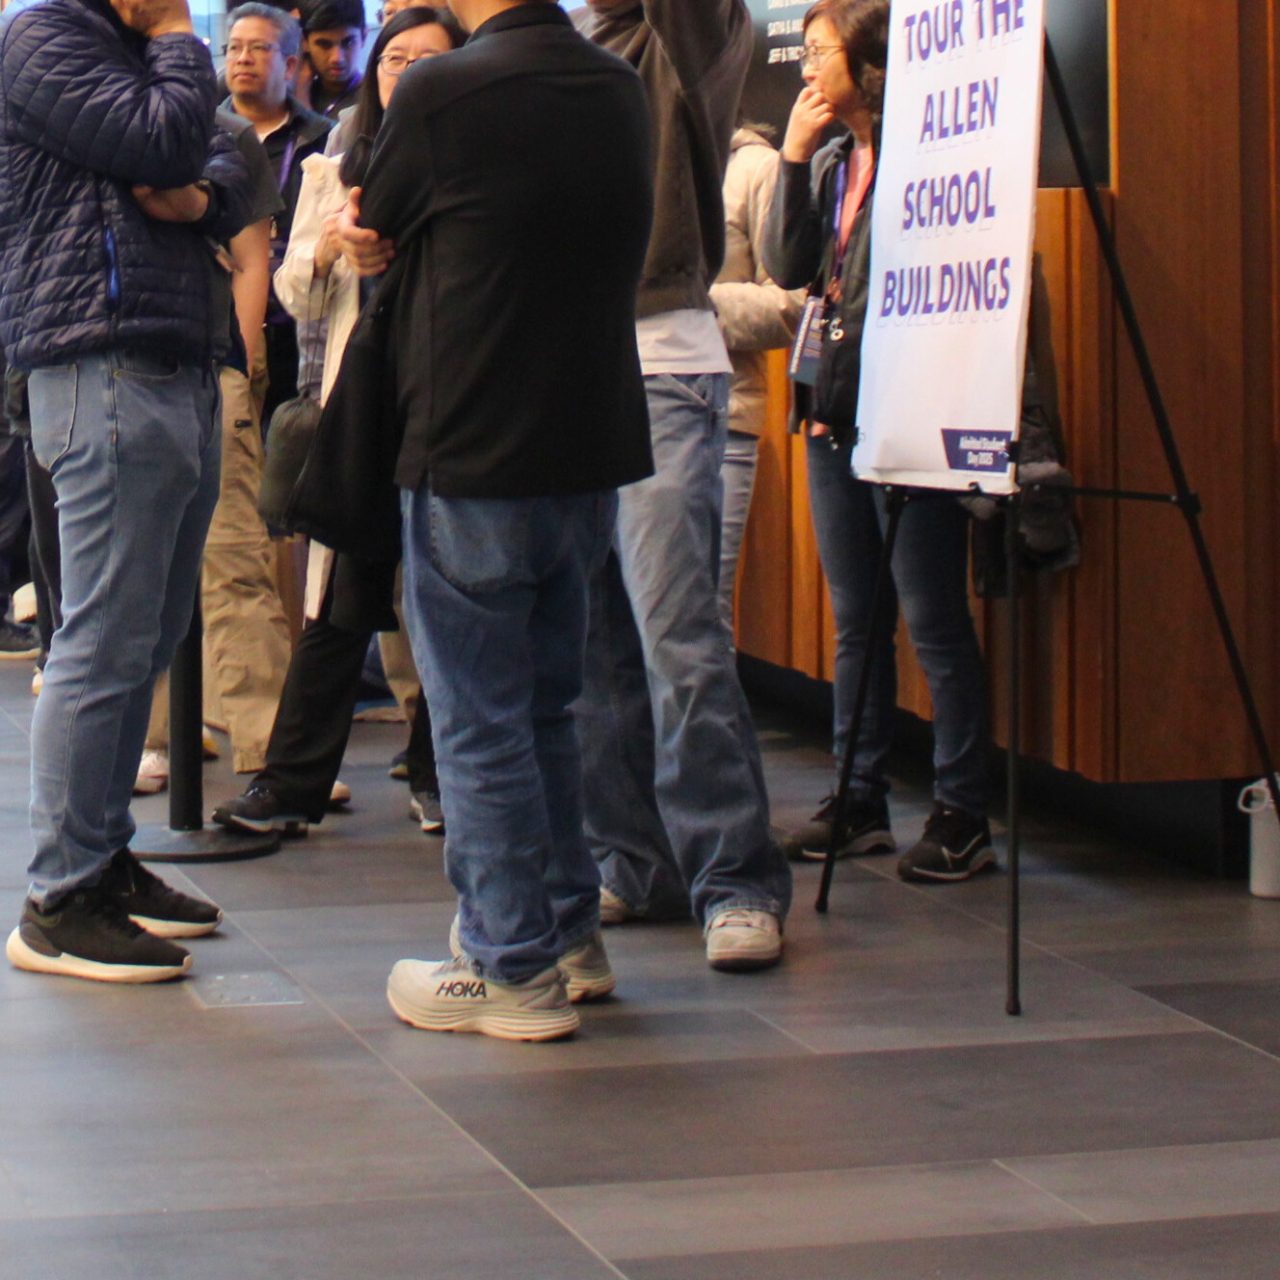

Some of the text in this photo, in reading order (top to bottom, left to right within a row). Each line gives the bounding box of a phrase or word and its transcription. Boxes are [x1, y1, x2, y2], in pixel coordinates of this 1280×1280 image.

[919, 76, 998, 144] ALLEN
[902, 167, 995, 231] SCHOOL
[880, 256, 1010, 317] BUILDINGS
[436, 980, 487, 999] HOKA
